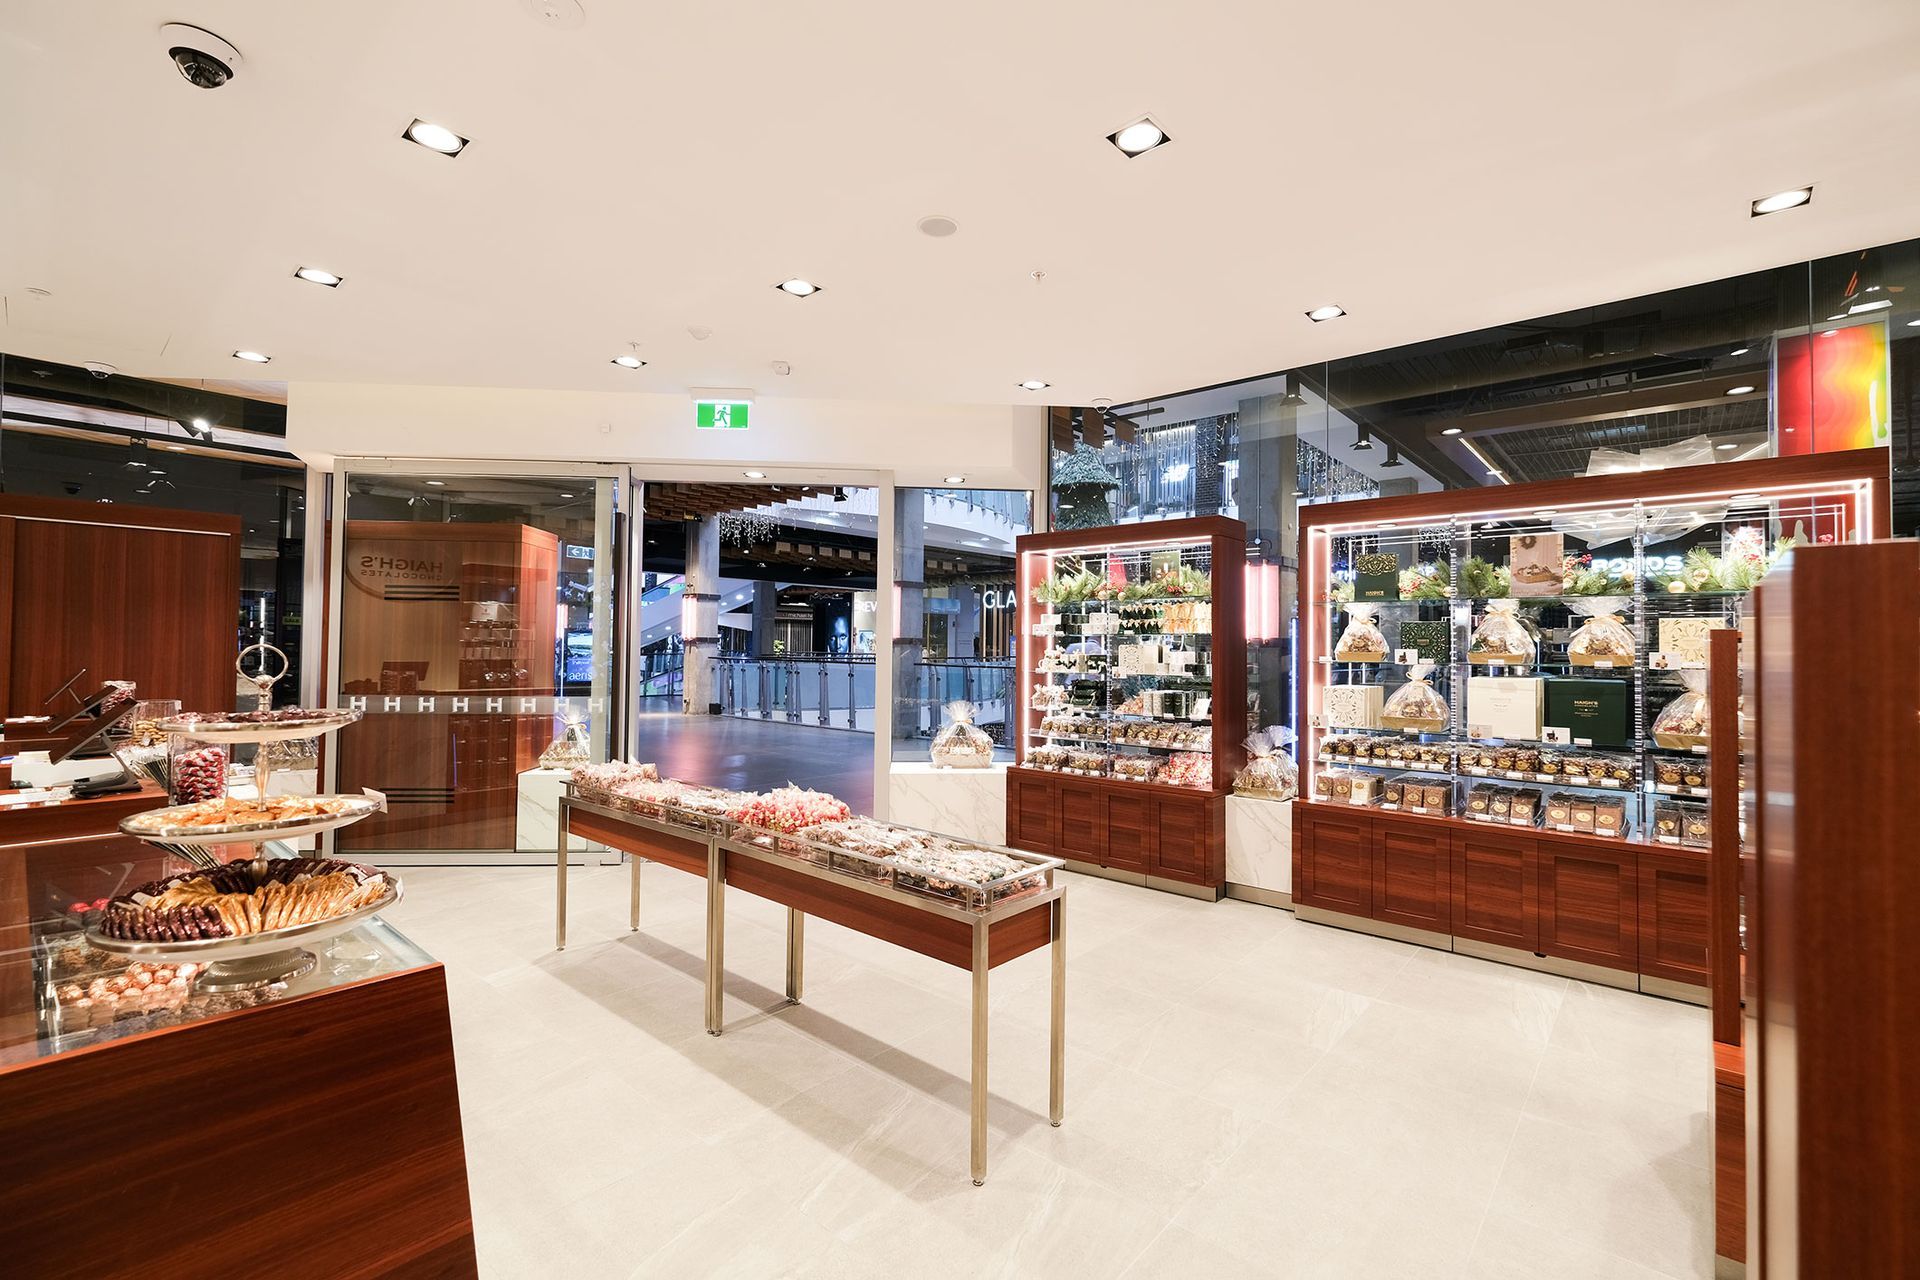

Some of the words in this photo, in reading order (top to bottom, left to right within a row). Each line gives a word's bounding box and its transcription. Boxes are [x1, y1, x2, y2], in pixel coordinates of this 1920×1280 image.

[982, 590, 1016, 609] GLA
[383, 696, 401, 712] H
[418, 697, 435, 713] H
[452, 697, 469, 713] H
[486, 697, 503, 713] H
[520, 697, 537, 713] H
[588, 697, 604, 713] H
